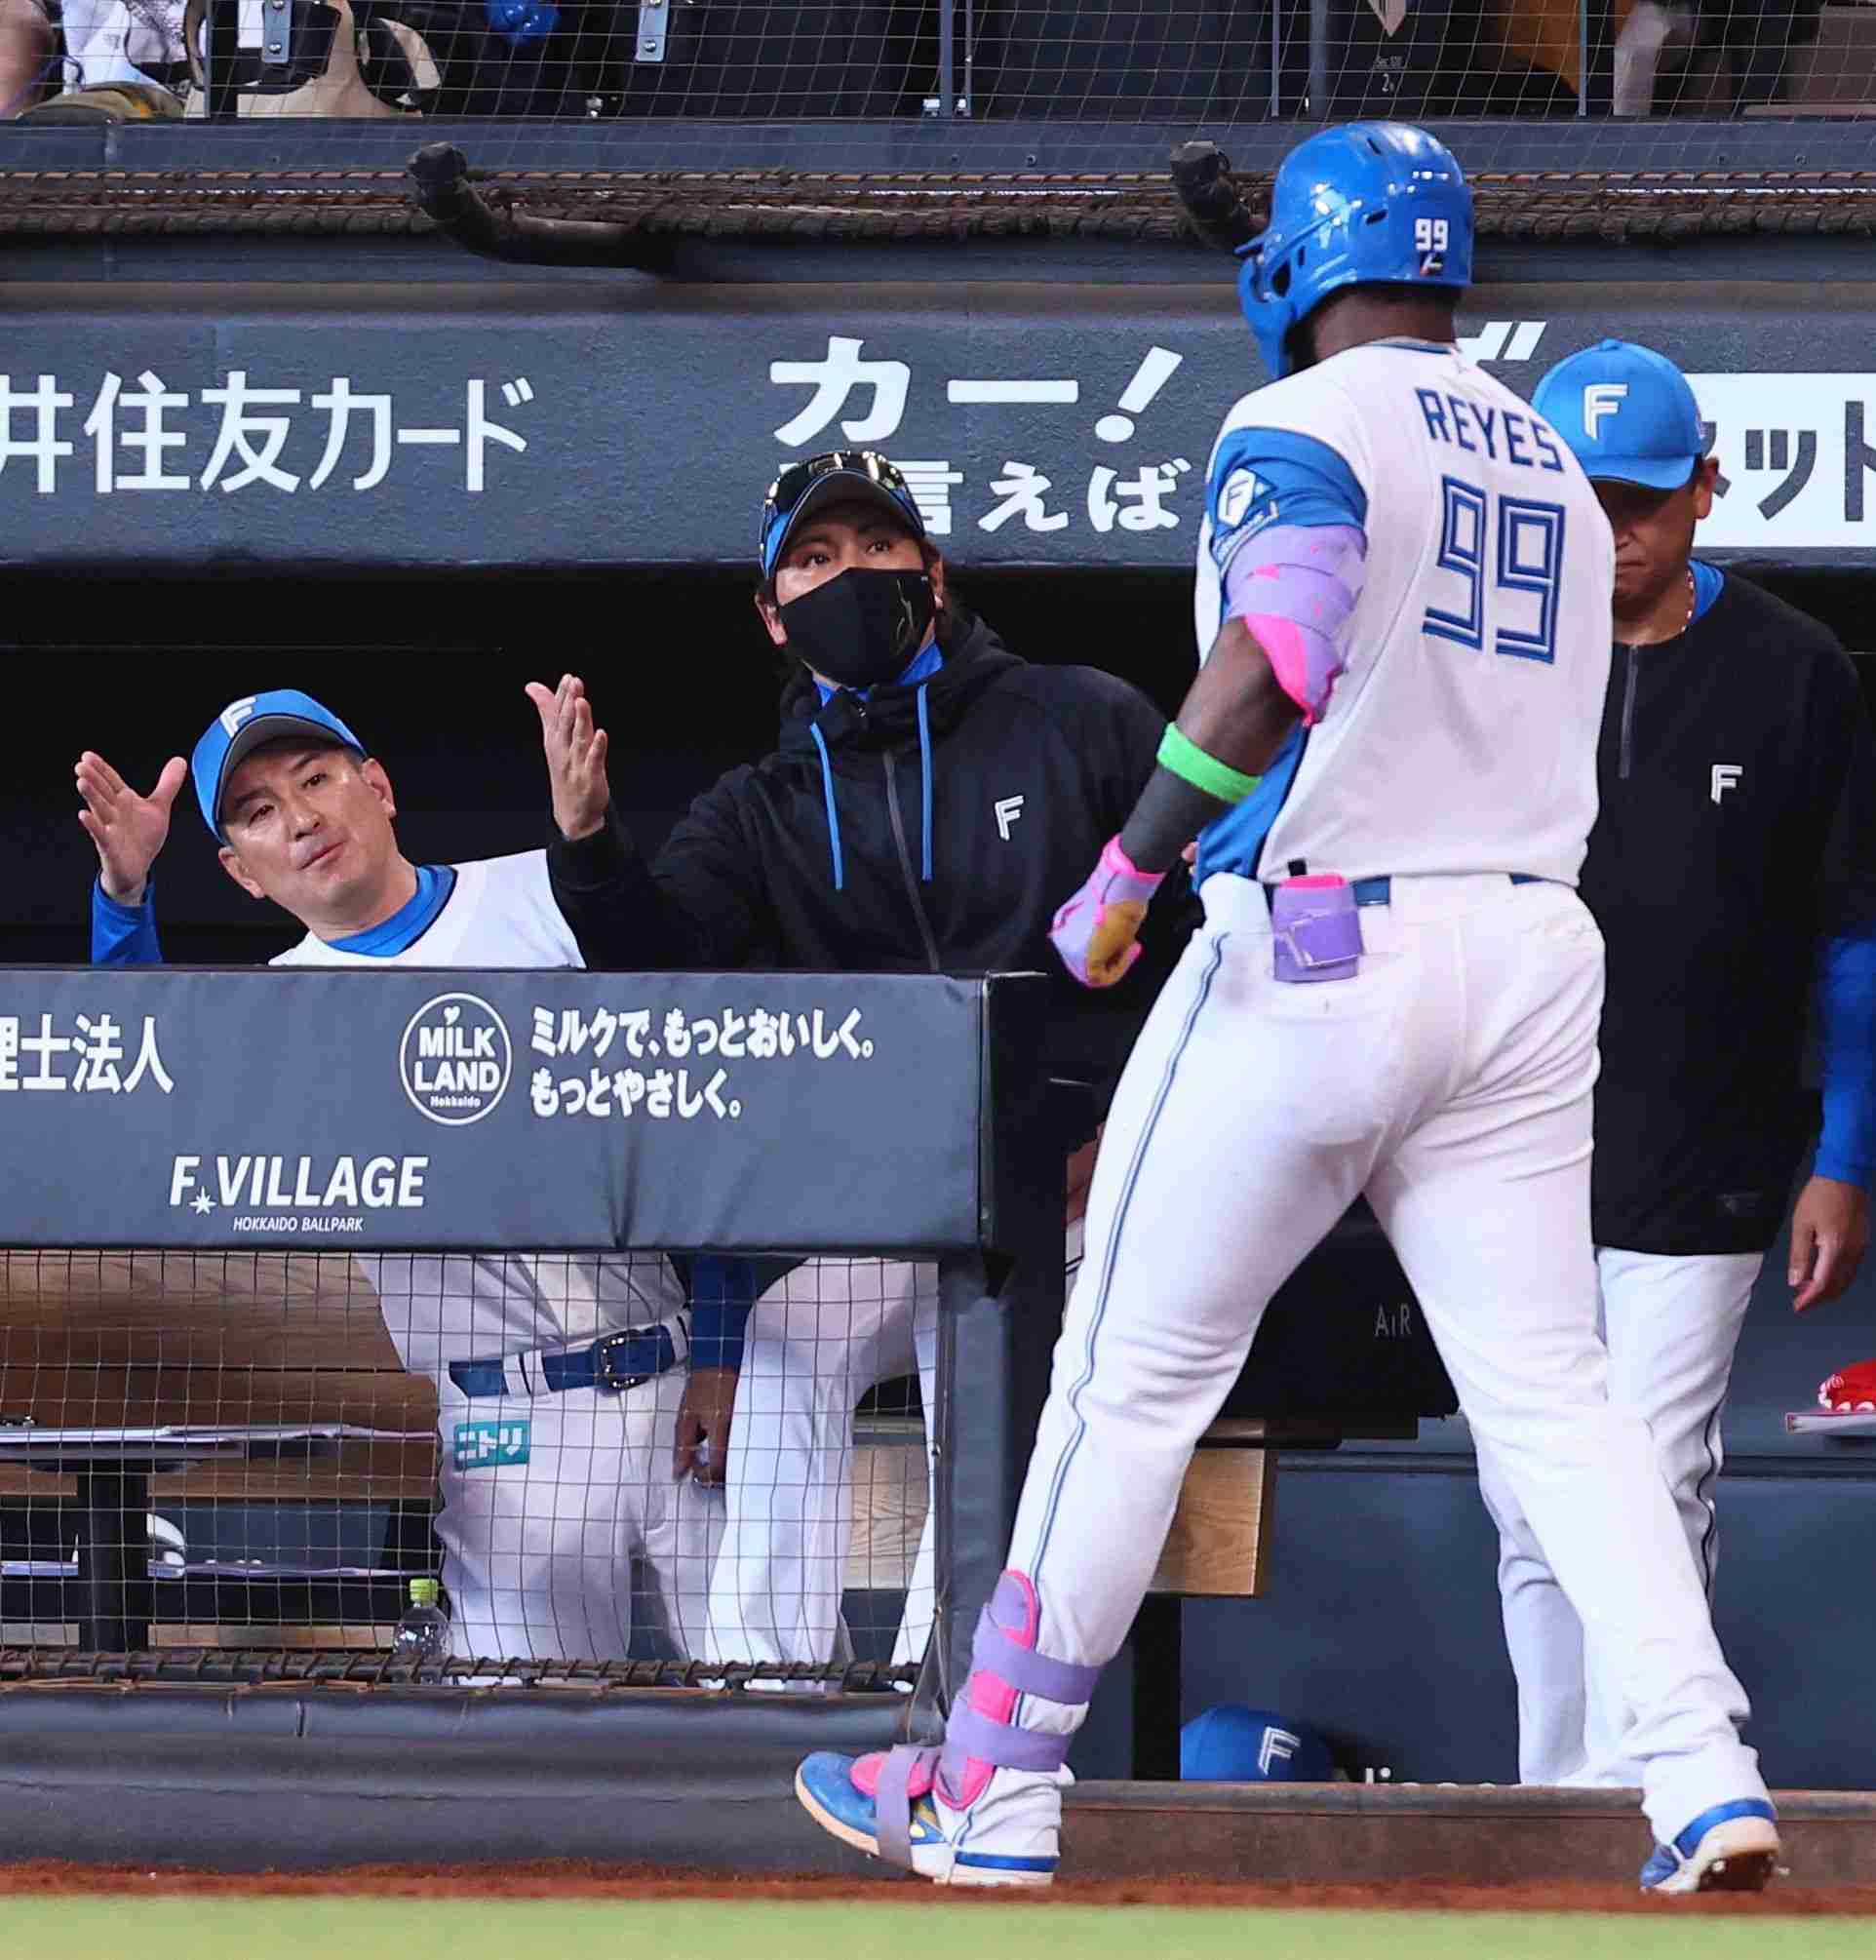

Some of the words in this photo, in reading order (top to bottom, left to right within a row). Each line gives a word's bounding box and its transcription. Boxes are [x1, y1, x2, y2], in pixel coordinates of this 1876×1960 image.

[1415, 217, 1449, 252] 99
[0, 370, 534, 493] 井住友カード
[1415, 387, 1565, 473] REYES
[1583, 383, 1629, 442] F
[1422, 475, 1566, 665] 99
[219, 696, 257, 739] F
[1710, 764, 1743, 804] F
[994, 795, 1025, 841] F
[530, 1006, 874, 1060] ミルクで、もっとおいしく。
[413, 1060, 501, 1092] LAND
[529, 1067, 742, 1119] もっとやさしく。
[429, 1095, 482, 1108] Hokkaido
[233, 1216, 298, 1233] HOKKAIDO
[301, 1216, 364, 1233] BALLPARK
[1258, 1726, 1301, 1776] F
